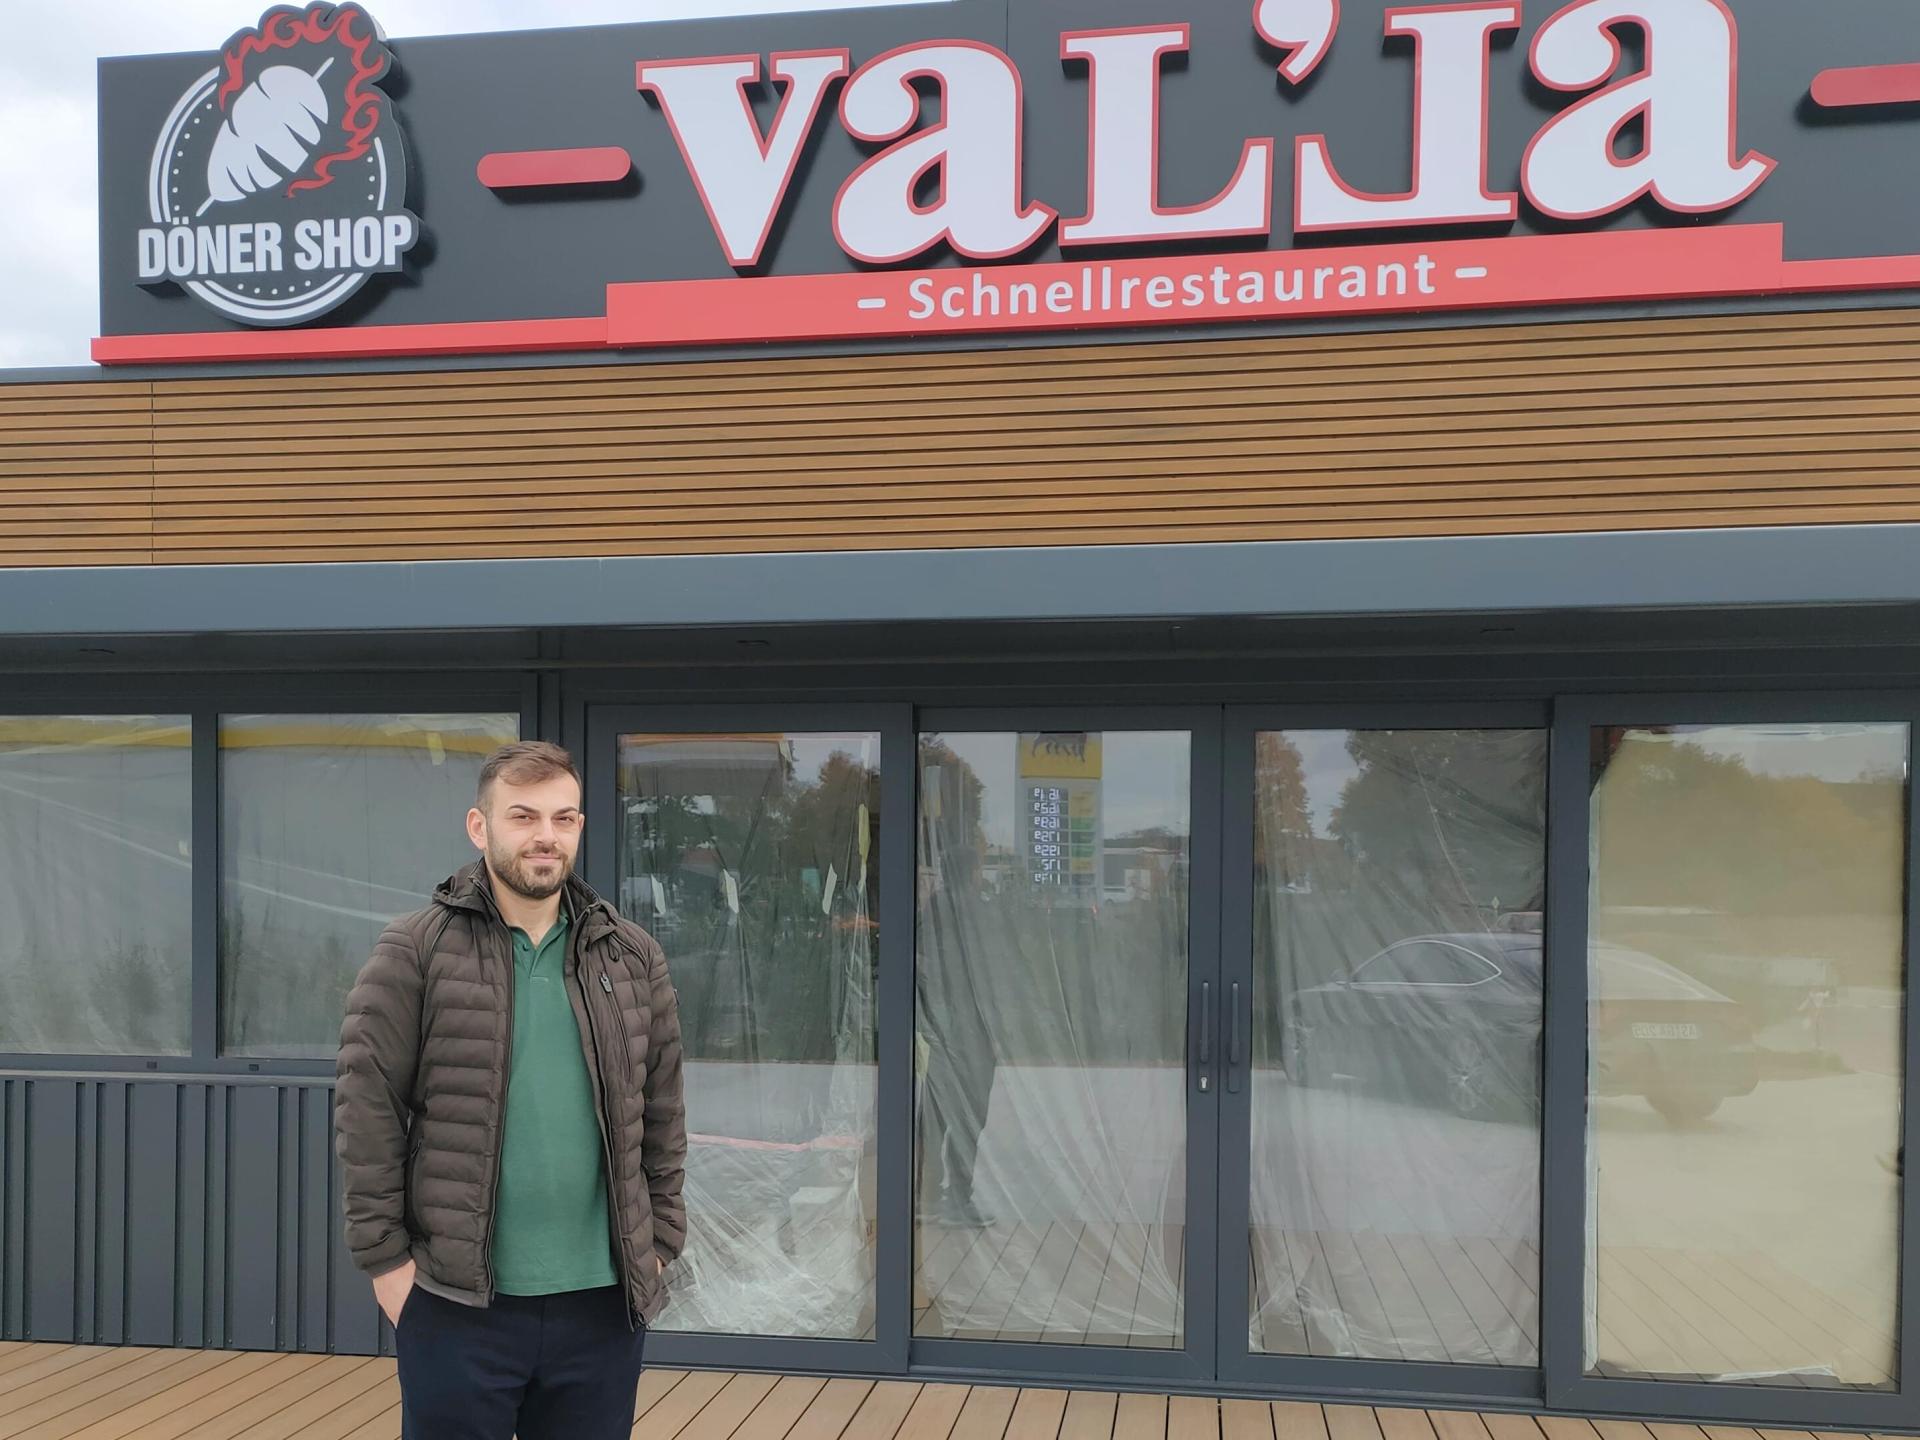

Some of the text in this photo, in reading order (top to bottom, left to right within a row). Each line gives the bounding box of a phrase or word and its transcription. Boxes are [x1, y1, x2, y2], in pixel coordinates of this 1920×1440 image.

[138, 215, 412, 278] DÖNER SHOP
[908, 254, 1436, 320] Schnellrestaurant
